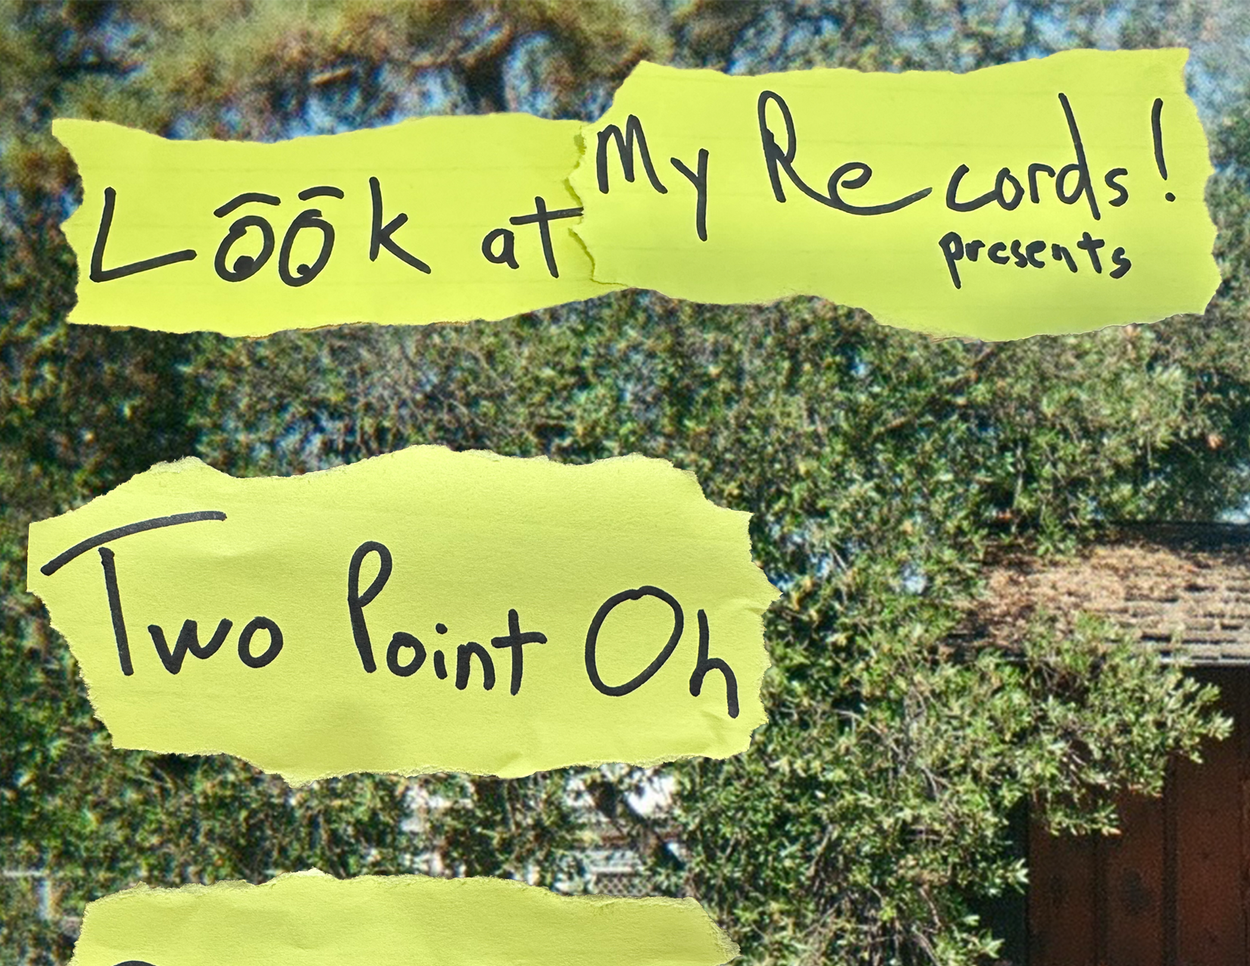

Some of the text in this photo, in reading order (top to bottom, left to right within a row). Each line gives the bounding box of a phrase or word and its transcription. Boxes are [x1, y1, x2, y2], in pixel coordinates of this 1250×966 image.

[480, 195, 585, 279] at
[594, 112, 710, 243] My
[757, 91, 1177, 222] Records!
[938, 230, 1133, 291] presents
[40, 510, 741, 719] Two Point Oh
